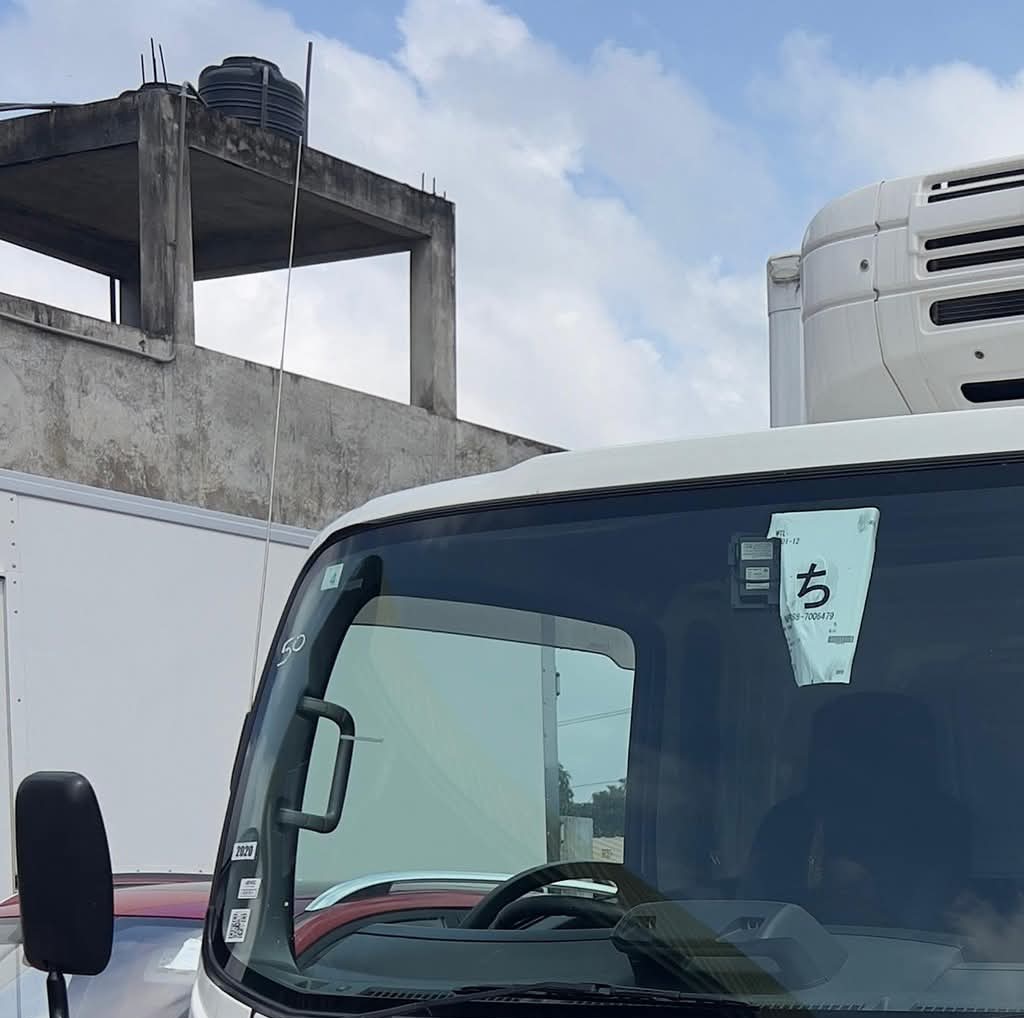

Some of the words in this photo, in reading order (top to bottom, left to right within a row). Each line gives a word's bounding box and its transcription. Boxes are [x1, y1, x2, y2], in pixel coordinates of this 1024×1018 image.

[796, 563, 830, 609] ち
[276, 633, 306, 667] 50
[235, 845, 254, 857] 2020
